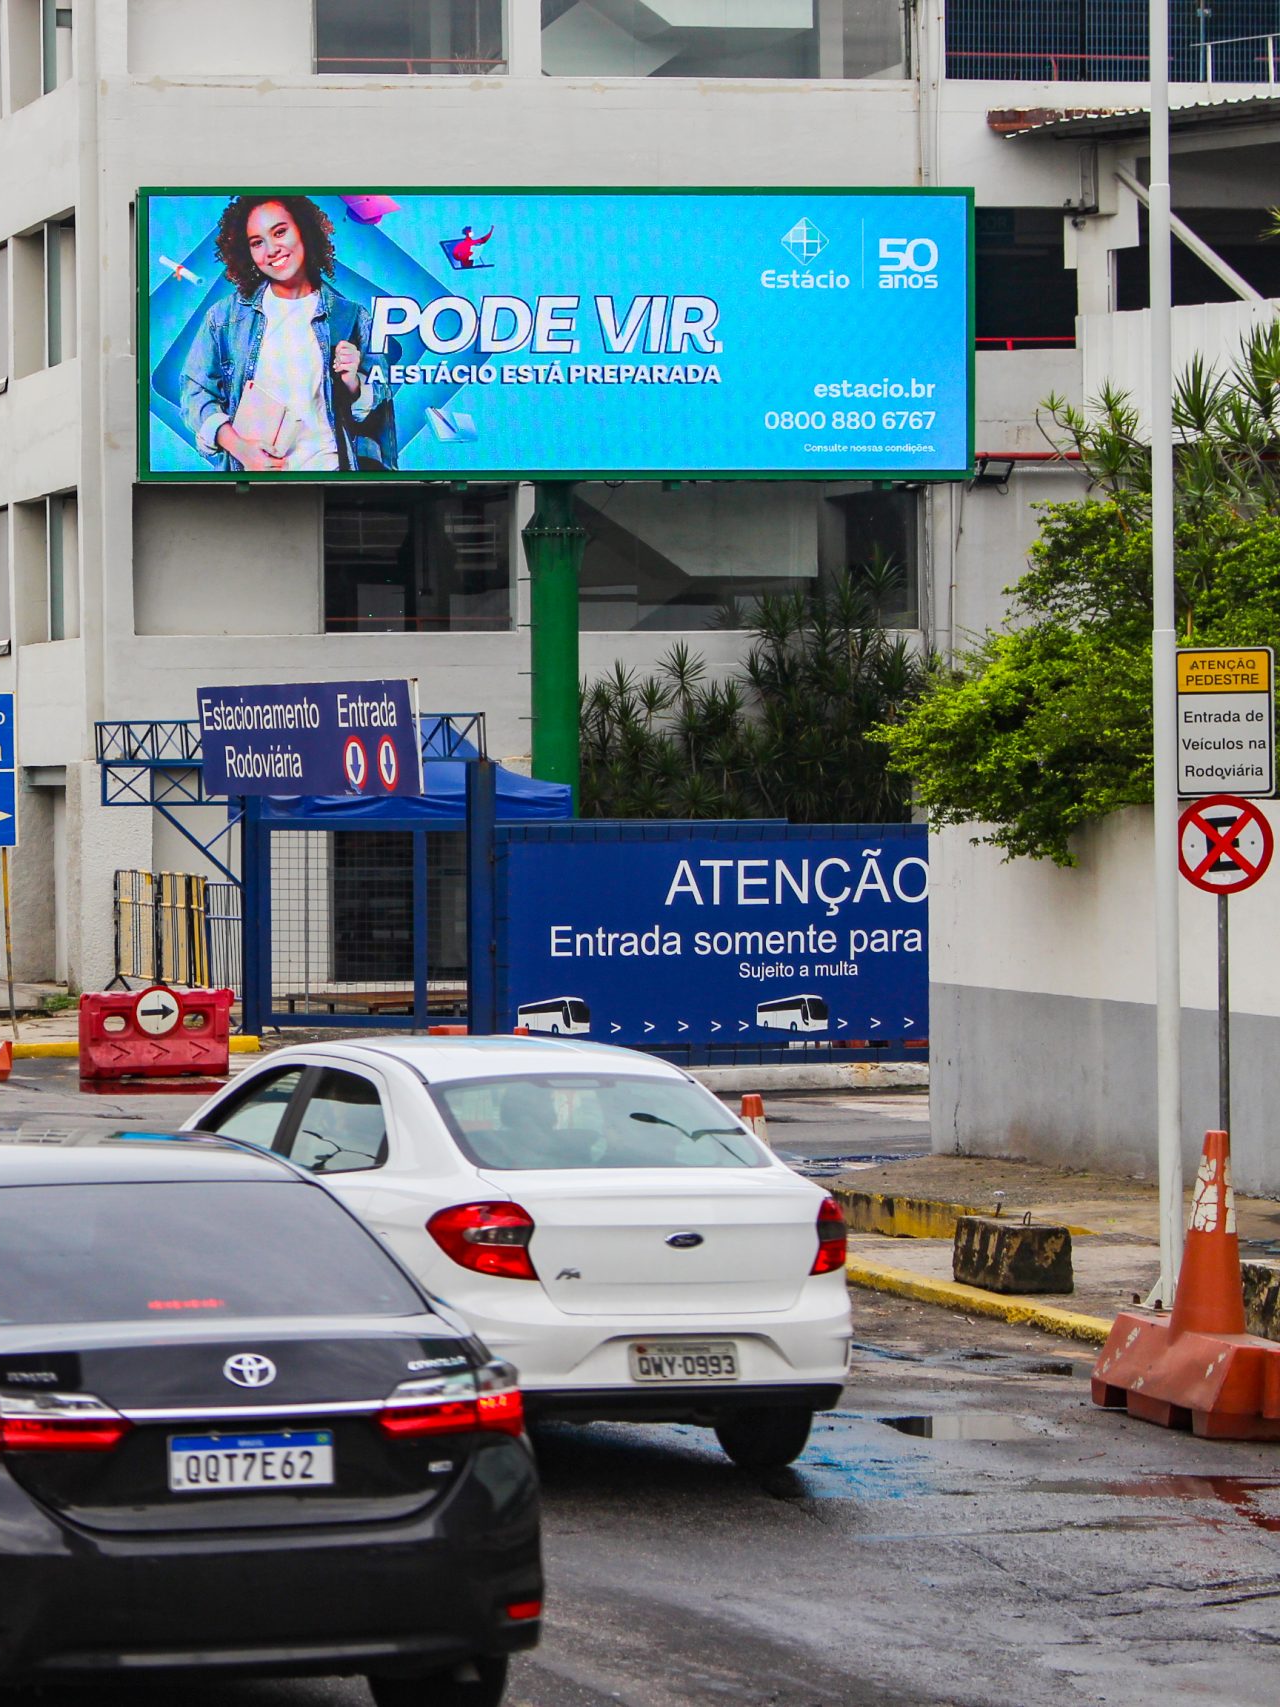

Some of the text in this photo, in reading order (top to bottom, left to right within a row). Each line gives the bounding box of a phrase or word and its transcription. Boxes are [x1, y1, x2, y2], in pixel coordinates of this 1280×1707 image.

[879, 238, 939, 272] 50
[760, 269, 850, 289] Estácio
[879, 274, 938, 289] anos
[368, 295, 580, 355] PODE
[365, 360, 722, 385] A ESTÁCIO ESTÁ PREPARADA
[813, 377, 936, 399] estacio.br
[764, 411, 936, 430] 0800 880 6767
[804, 443, 848, 453] Consulte
[850, 445, 883, 453] nossas
[1190, 658, 1256, 672] ATENÇÃO
[1185, 673, 1260, 686] PEDESTRE
[201, 697, 320, 731] Estacionamento
[336, 692, 398, 728] Entrada
[1183, 710, 1264, 723] Entrada de
[1182, 737, 1267, 750] Veículos na
[224, 744, 303, 778] Rodoviária
[1185, 763, 1264, 778] Rodoviária
[664, 848, 929, 917] ATENÇÃO
[550, 923, 923, 961] Entrada somente para
[738, 961, 859, 982] Sujeito a multa
[185, 1451, 315, 1484] QQT7E62
